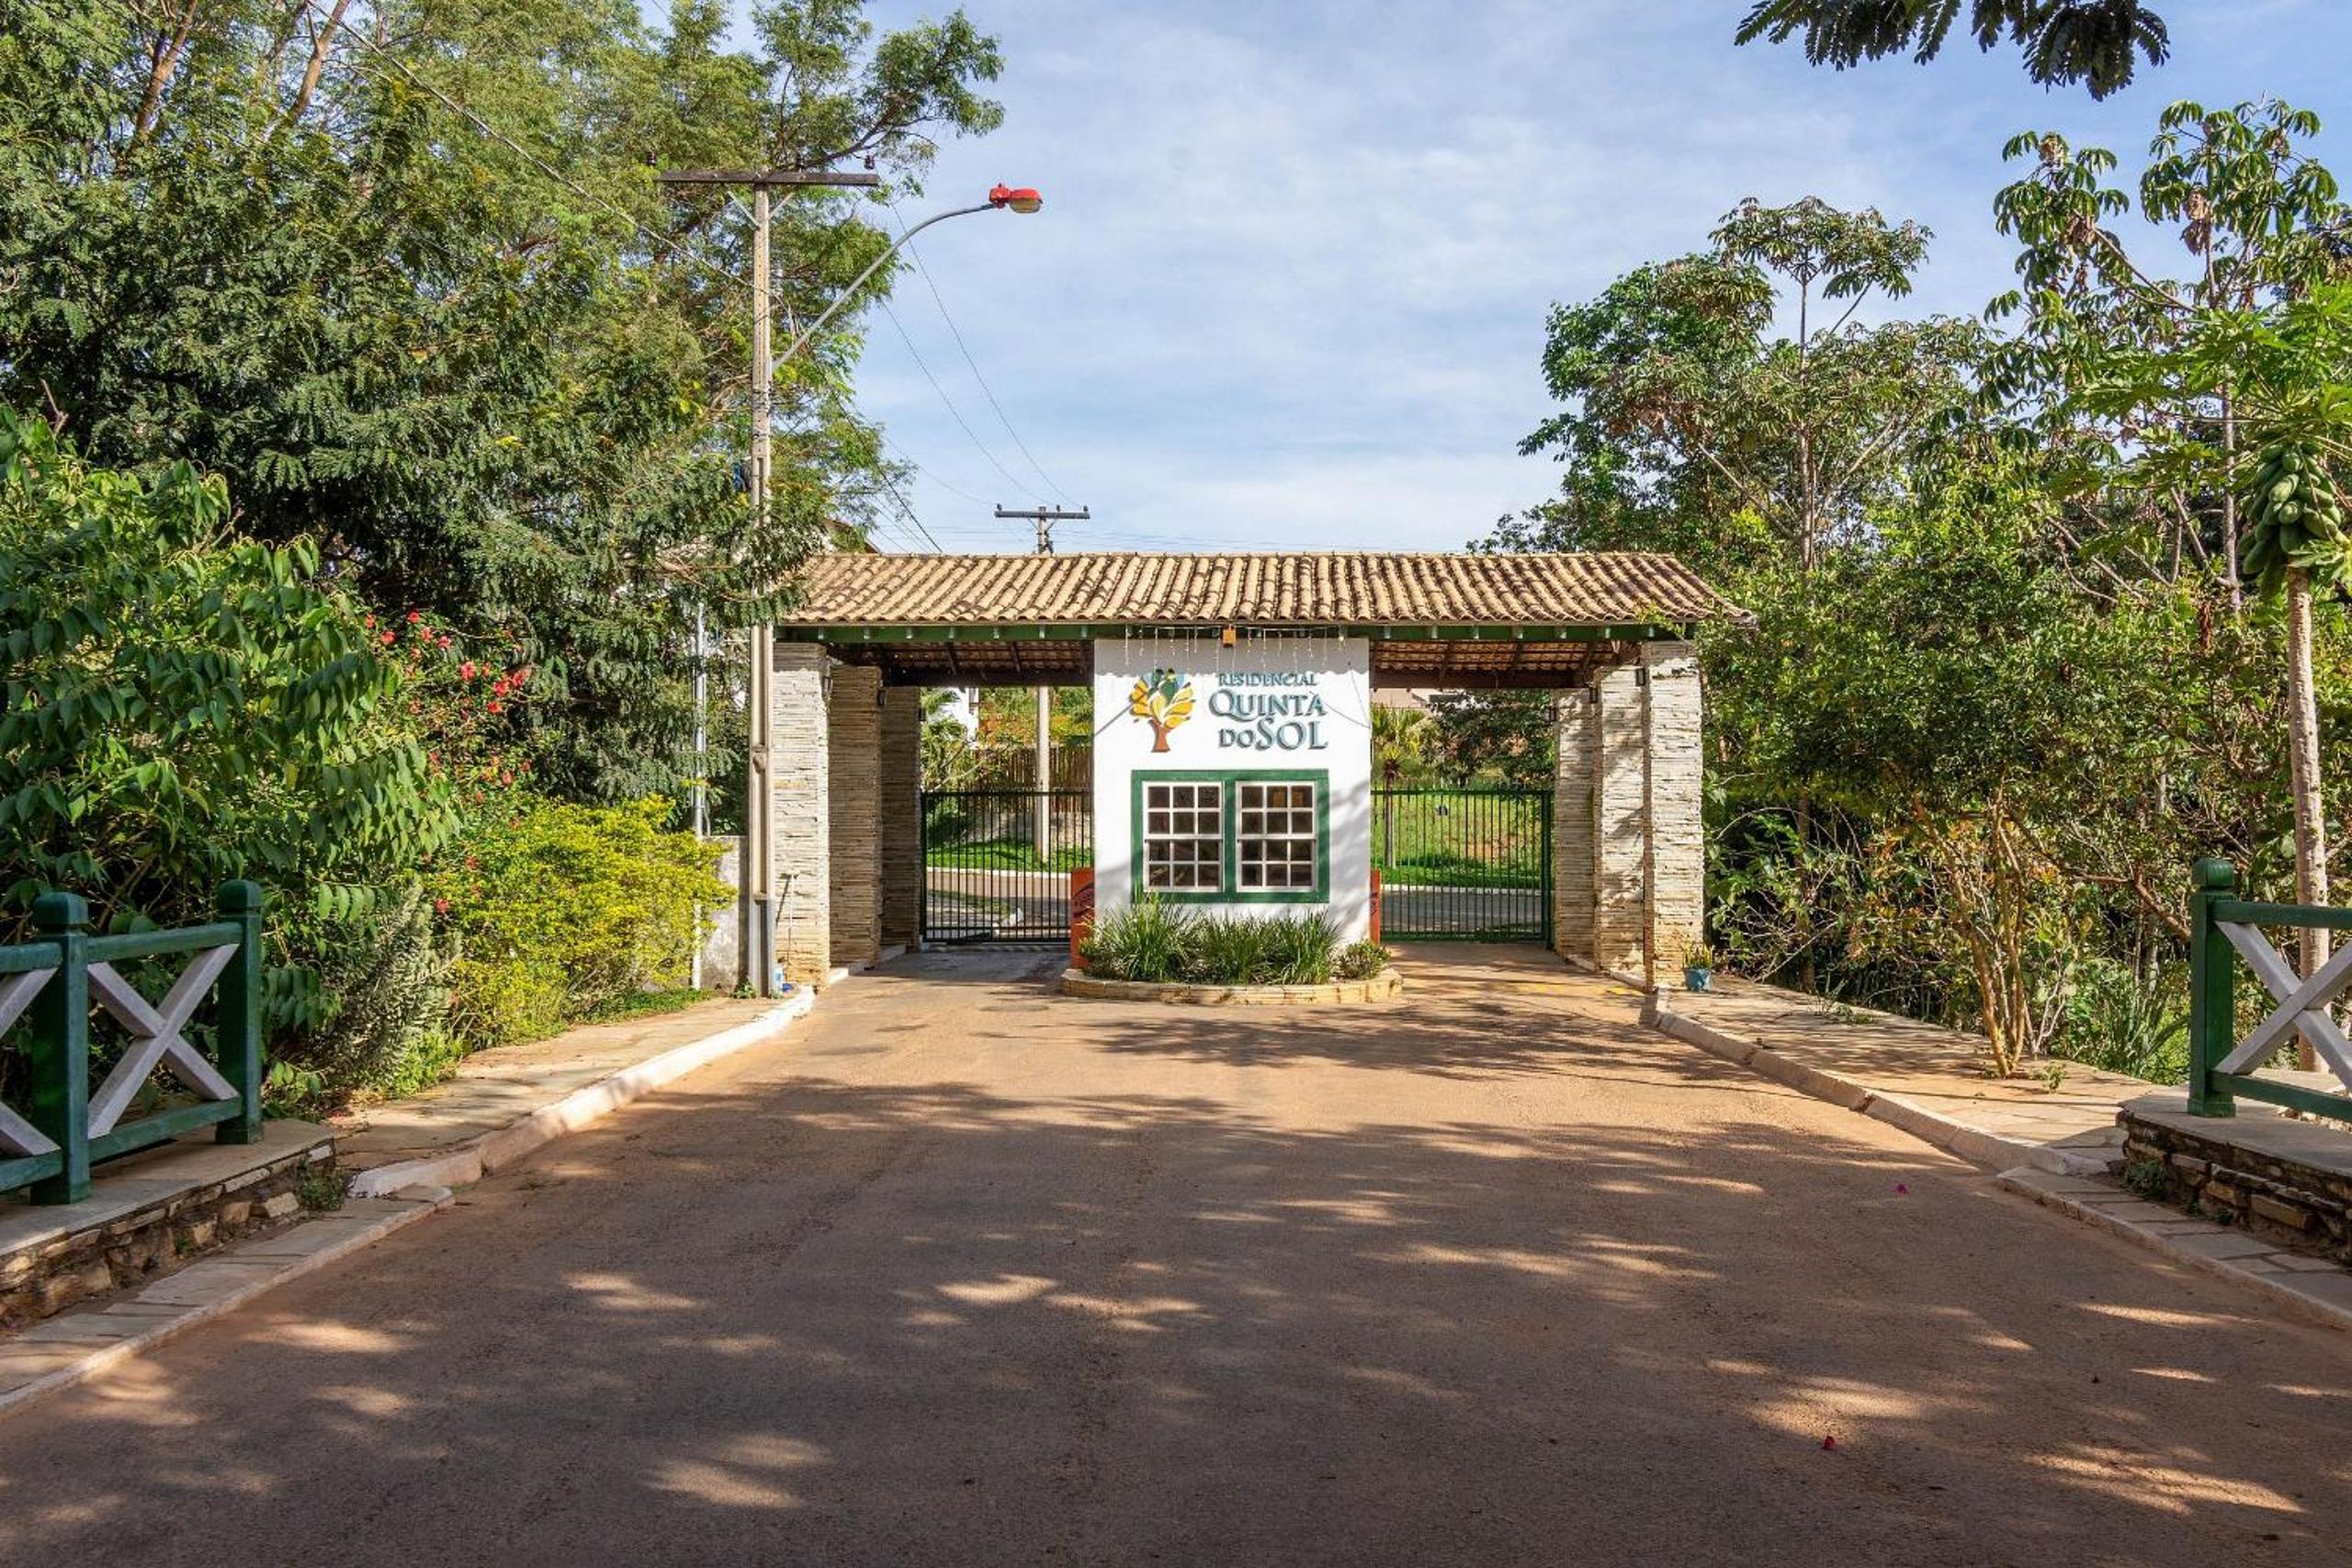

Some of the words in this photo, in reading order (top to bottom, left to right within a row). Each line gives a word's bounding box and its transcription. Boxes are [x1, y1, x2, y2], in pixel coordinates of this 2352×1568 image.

[1218, 673, 1318, 686] RESIDENCIAL
[1209, 689, 1328, 722] QUINTA
[1255, 716, 1329, 750] SOL
